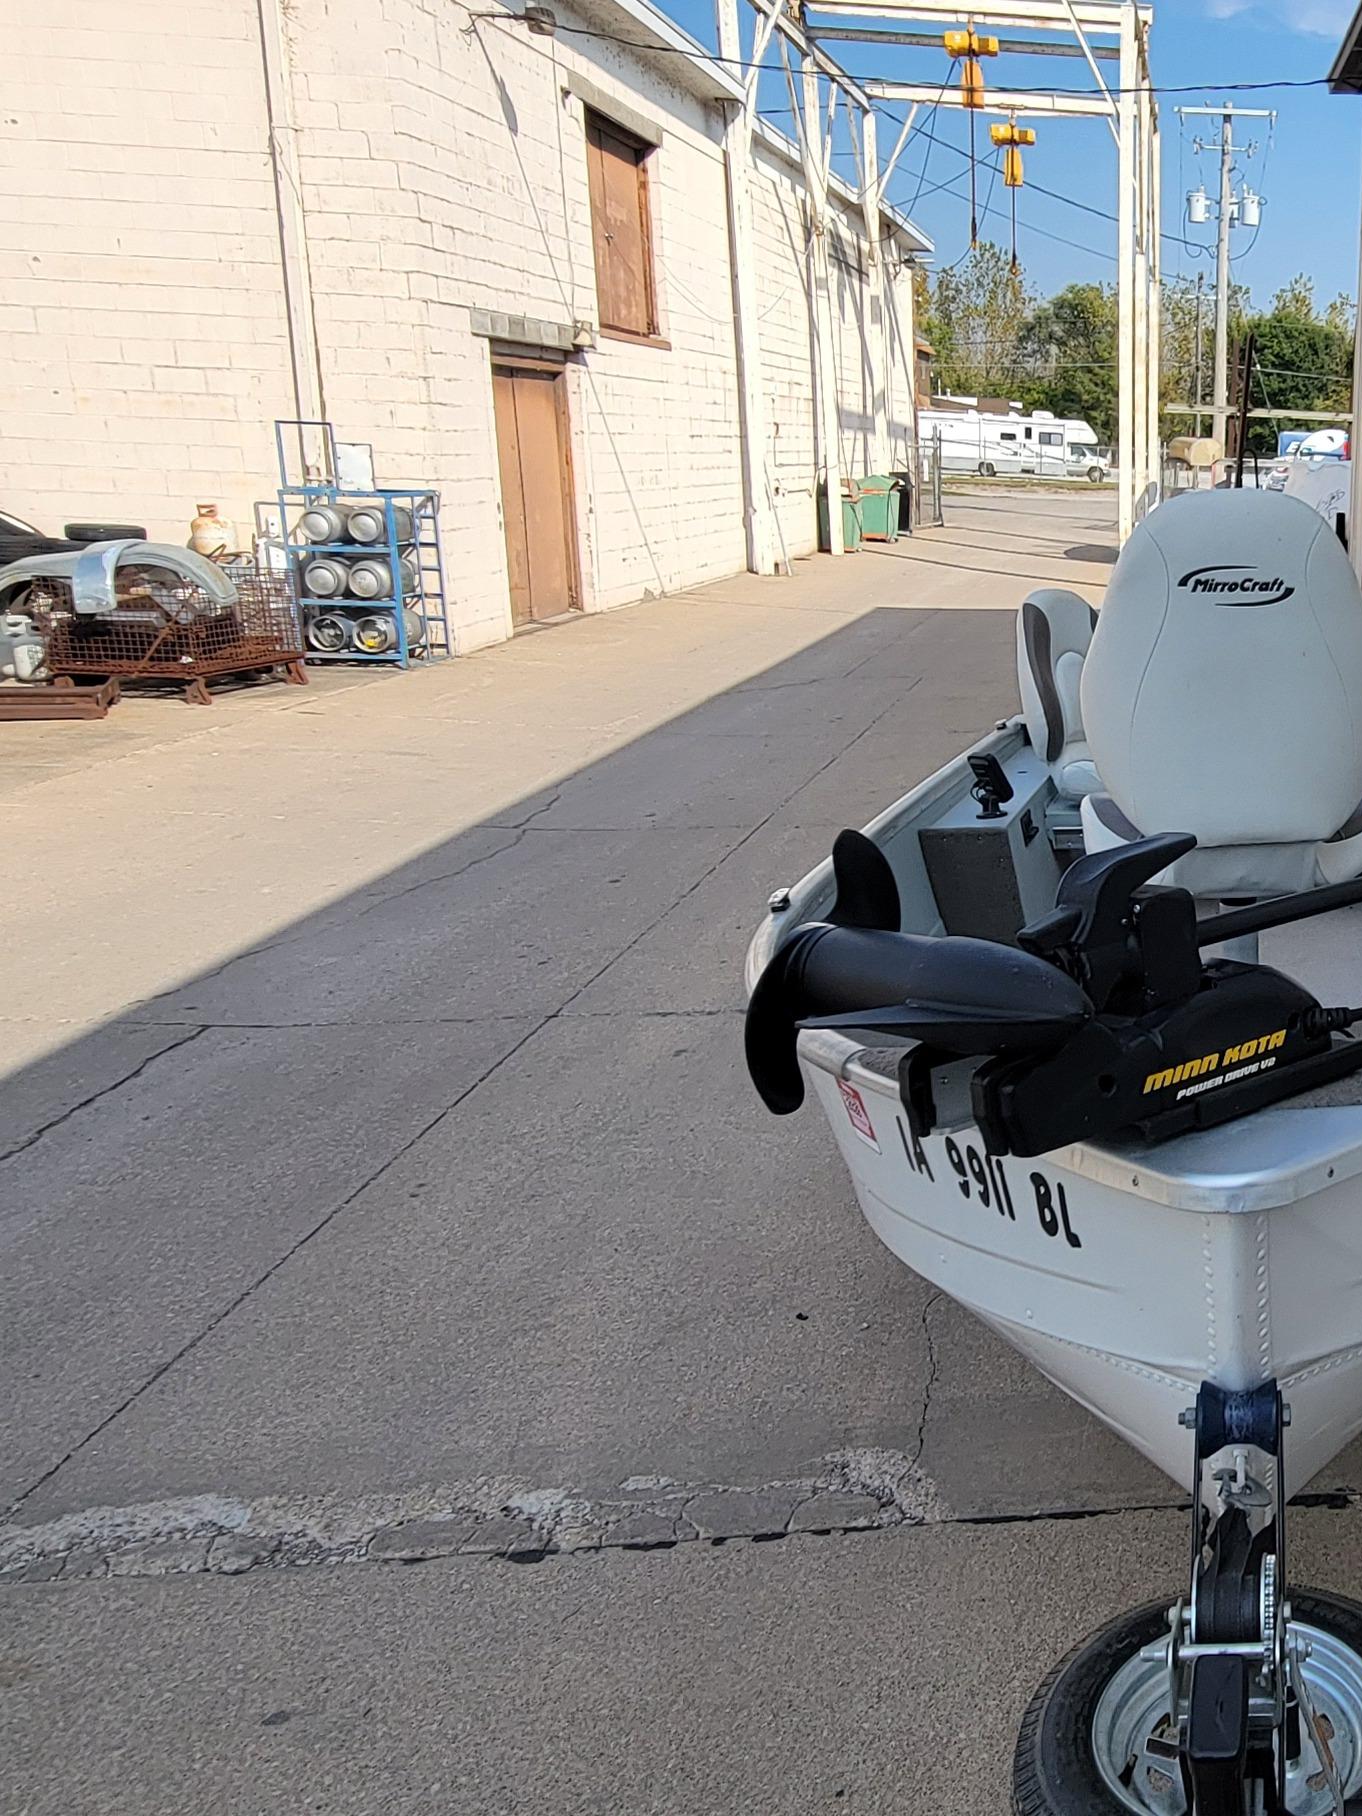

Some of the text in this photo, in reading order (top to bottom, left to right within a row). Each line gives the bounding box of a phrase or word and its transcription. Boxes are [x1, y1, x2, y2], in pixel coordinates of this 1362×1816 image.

[1191, 577, 1284, 593] MirroCraft
[1143, 1029, 1287, 1094] MINN KOTA
[1176, 1056, 1277, 1100] POWER DRIVE V2
[945, 1136, 1016, 1221] 9911
[1030, 1172, 1082, 1248] BL
